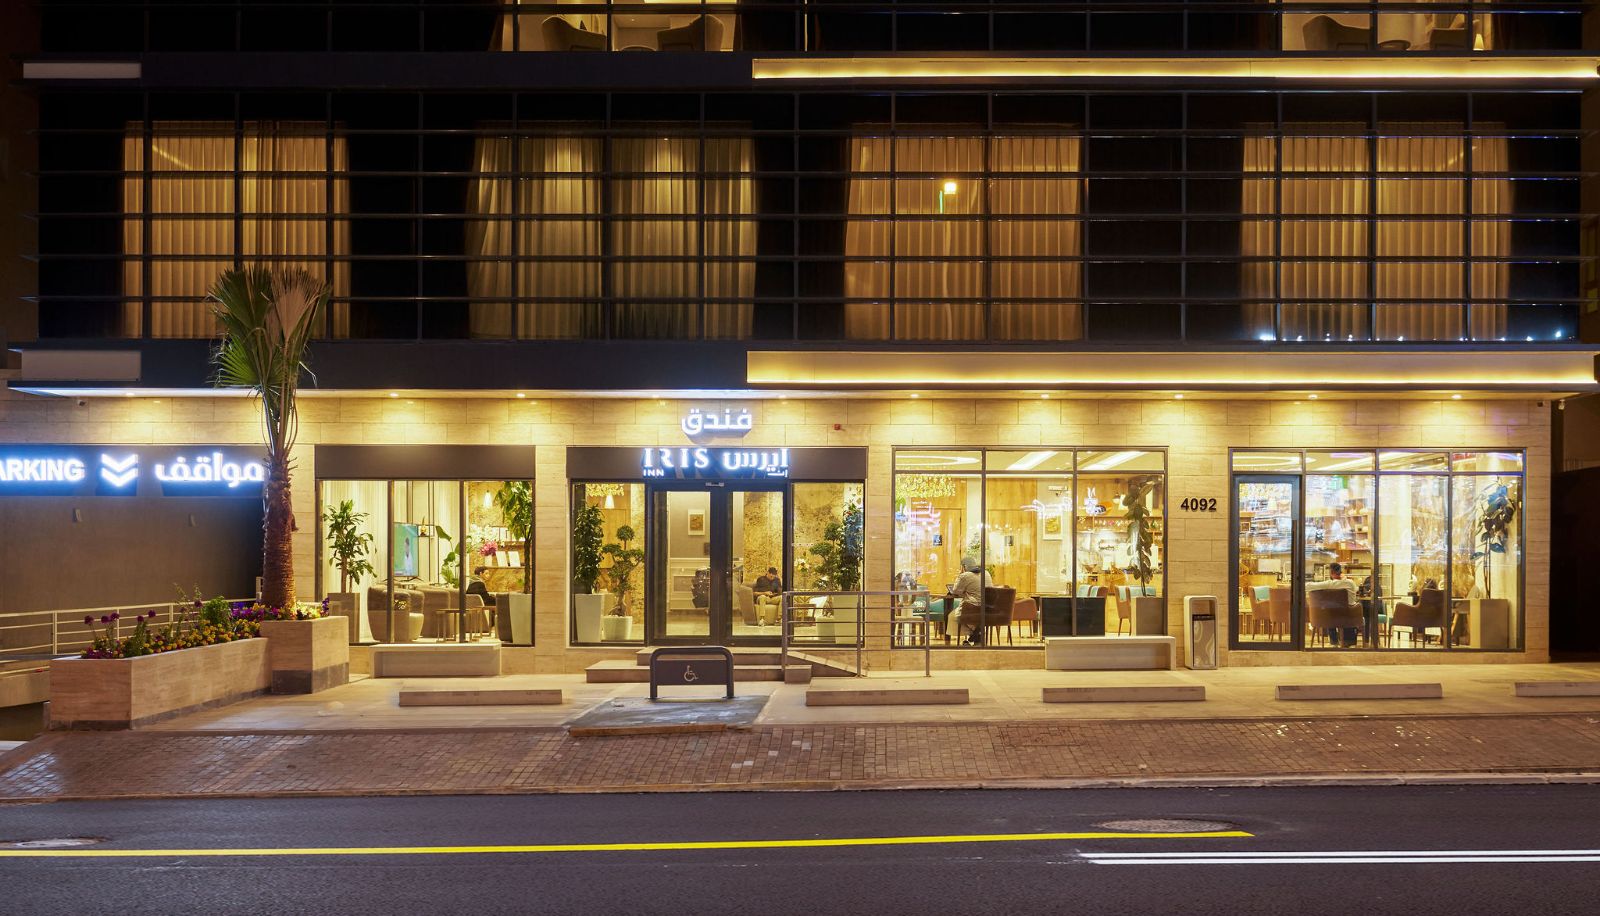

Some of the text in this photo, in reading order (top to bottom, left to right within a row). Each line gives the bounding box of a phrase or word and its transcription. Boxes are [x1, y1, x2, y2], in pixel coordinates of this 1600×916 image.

[681, 408, 752, 435] فندق
[643, 448, 710, 468] IRIS
[154, 452, 265, 488] مواقف
[643, 469, 665, 477] INN
[1180, 497, 1217, 512] 4092
